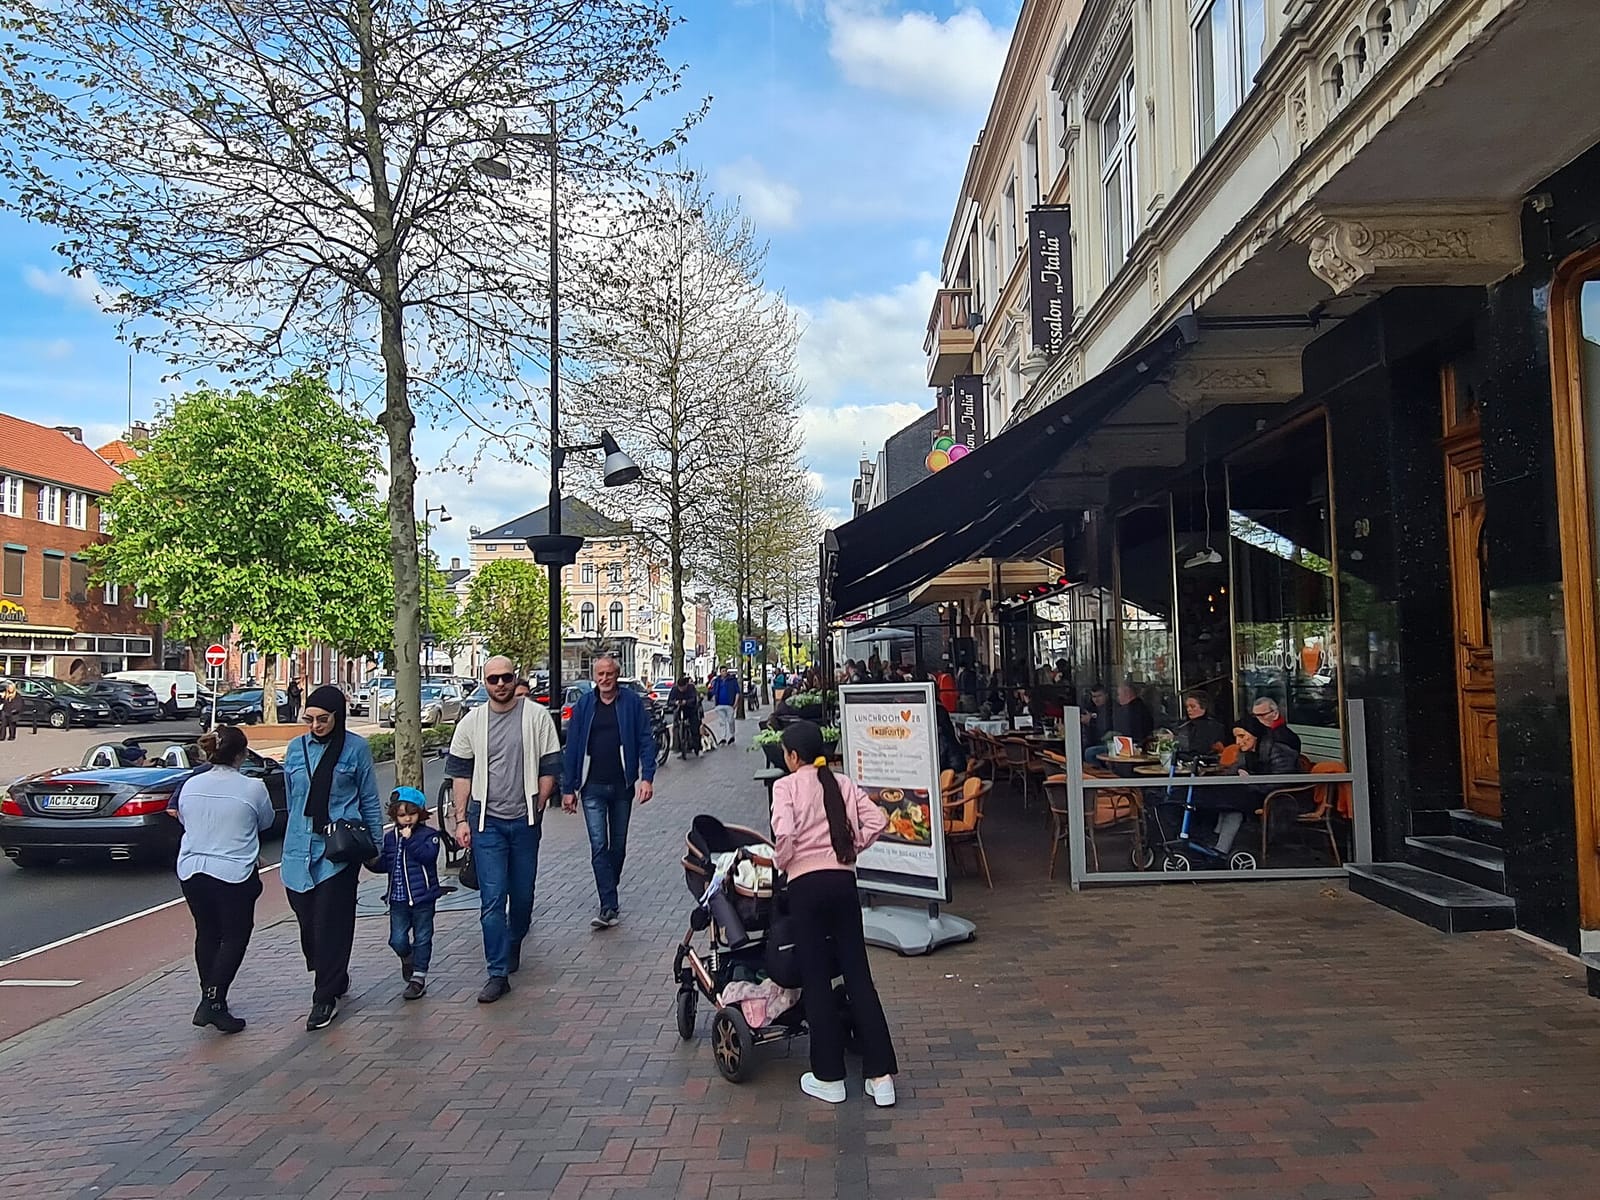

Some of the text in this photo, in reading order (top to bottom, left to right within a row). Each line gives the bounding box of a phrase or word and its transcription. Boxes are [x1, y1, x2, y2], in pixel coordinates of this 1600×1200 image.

[744, 641, 753, 653] P
[855, 714, 900, 722] LUNCHROOM
[49, 796, 97, 806] AC AZ 448
